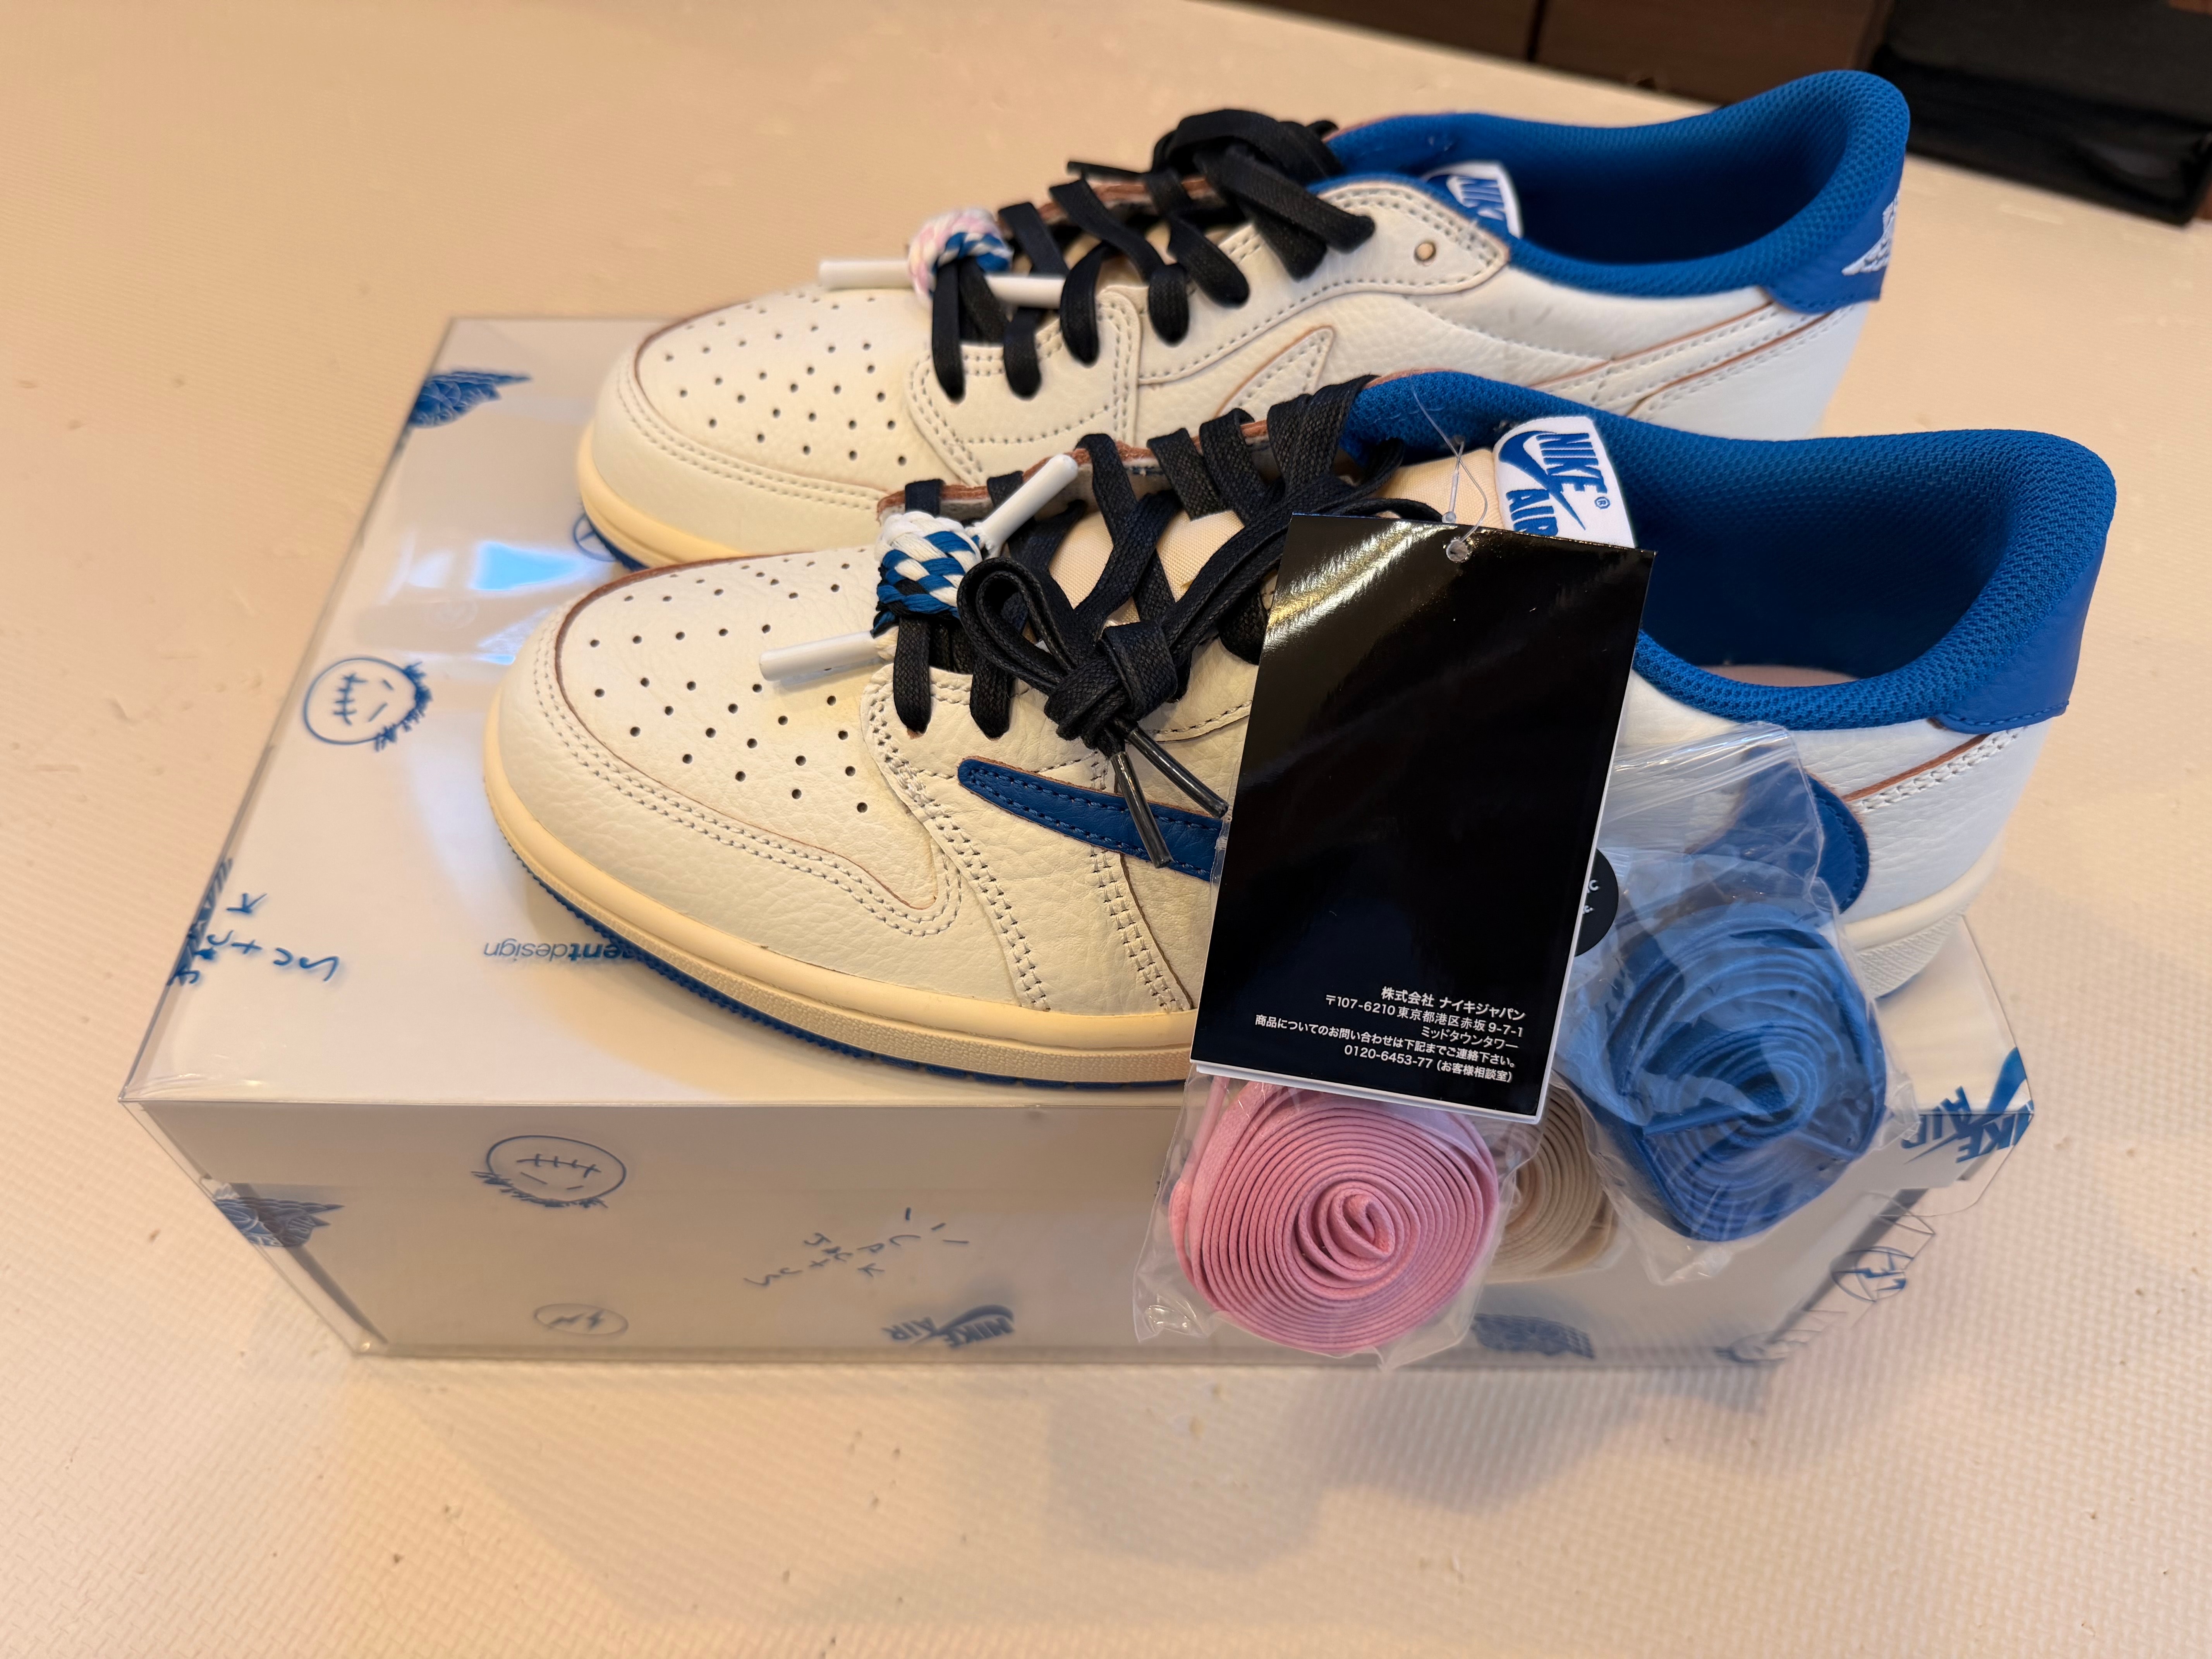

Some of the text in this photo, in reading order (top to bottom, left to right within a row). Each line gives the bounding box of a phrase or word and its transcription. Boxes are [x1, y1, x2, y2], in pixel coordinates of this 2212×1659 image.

[1536, 433, 1607, 494] NIKE
[1506, 489, 1558, 536] AIR
[1381, 986, 1527, 1021] 株式会社 ナイキジャパン
[1255, 1014, 1516, 1068] 商品についてのお問い合わせは下記までご連絡下さい。
[1421, 1025, 1520, 1049] ミッドタウンタワー
[1344, 1044, 1513, 1083] 0120-6453-77 (お客様相談室)
[881, 1317, 936, 1340] AIR
[943, 1316, 1015, 1349] NIKE
